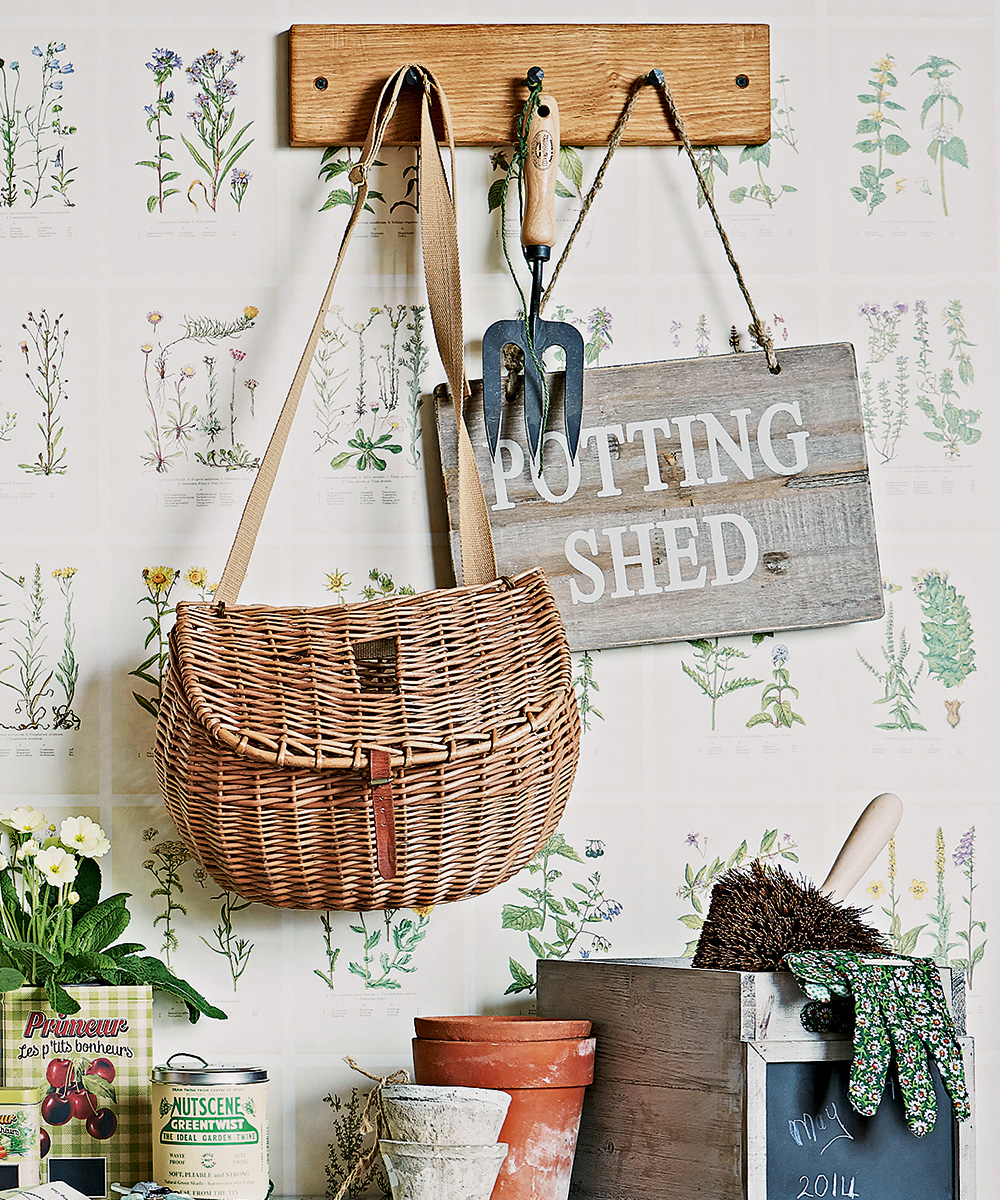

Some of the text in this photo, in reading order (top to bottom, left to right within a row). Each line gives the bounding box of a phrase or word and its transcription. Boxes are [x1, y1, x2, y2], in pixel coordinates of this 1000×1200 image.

[482, 401, 810, 511] POTTING
[564, 513, 759, 605] SHED
[23, 1011, 129, 1039] Primeur
[17, 1039, 133, 1060] Les p'tits bonheurs
[171, 1096, 245, 1117] NUTSCENE
[171, 1119, 245, 1131] GREENTWIST
[177, 1133, 197, 1141] IDEAL
[796, 1172, 860, 1199] 2014
